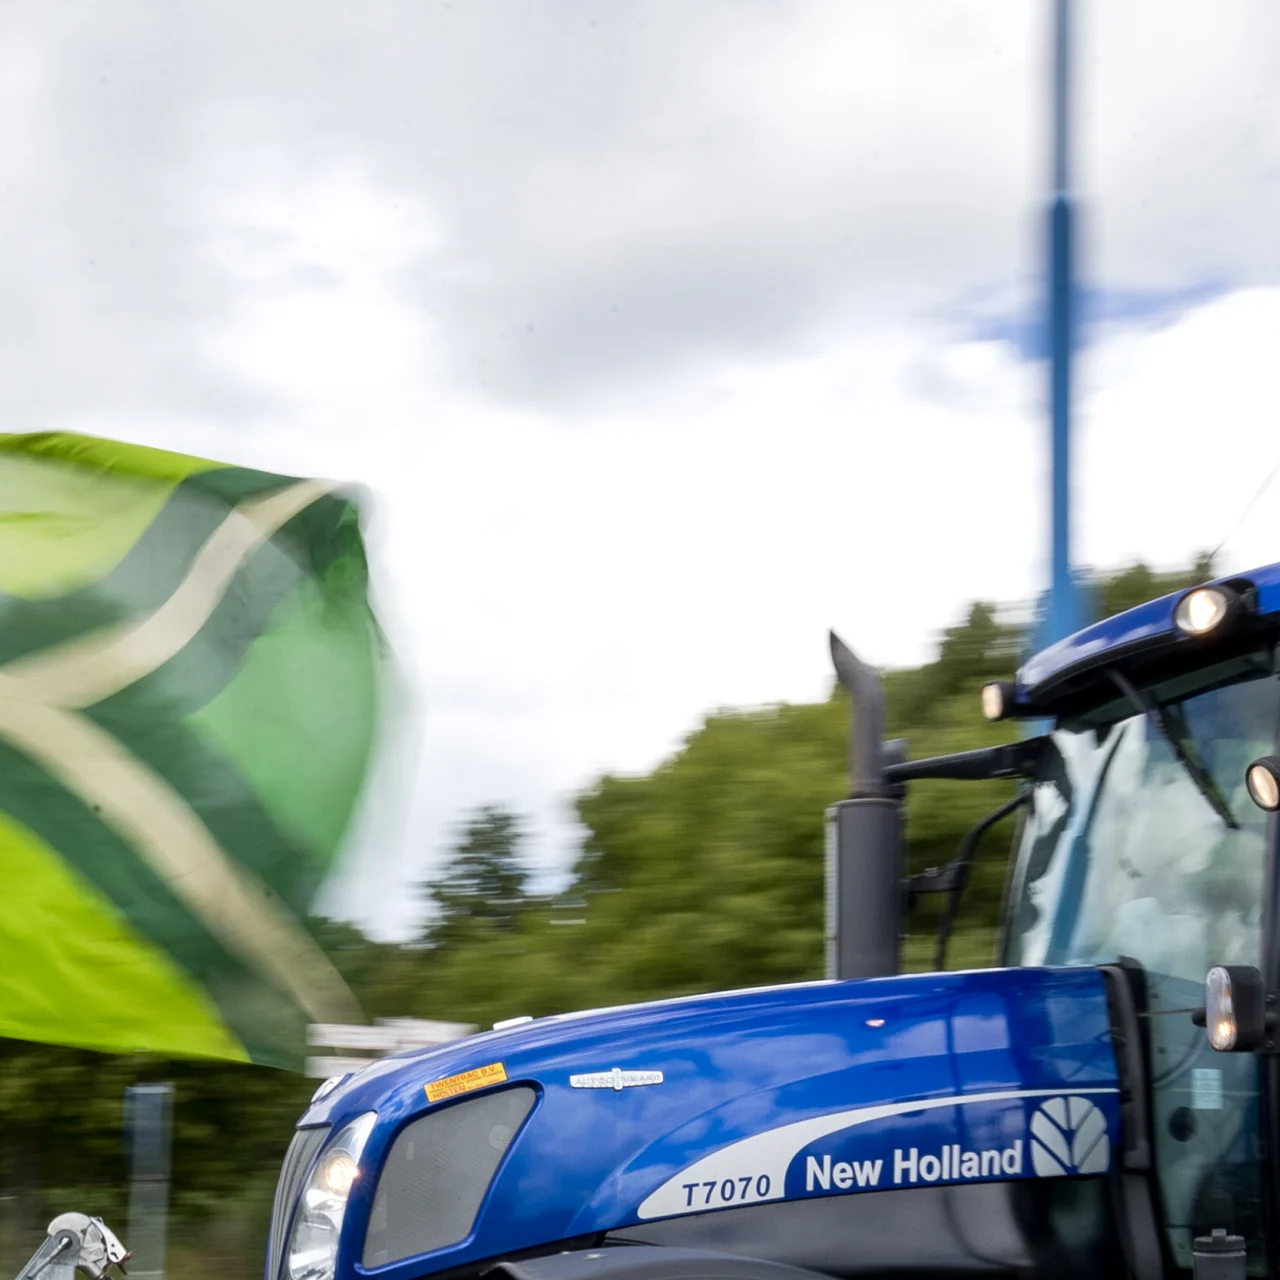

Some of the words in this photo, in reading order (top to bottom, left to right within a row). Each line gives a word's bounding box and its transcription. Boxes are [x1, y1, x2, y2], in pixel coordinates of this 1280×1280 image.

[430, 1070, 479, 1090] TWENTRAC
[806, 1155, 883, 1192] New
[893, 1139, 1023, 1184] Holland
[683, 1174, 771, 1207] T7070
